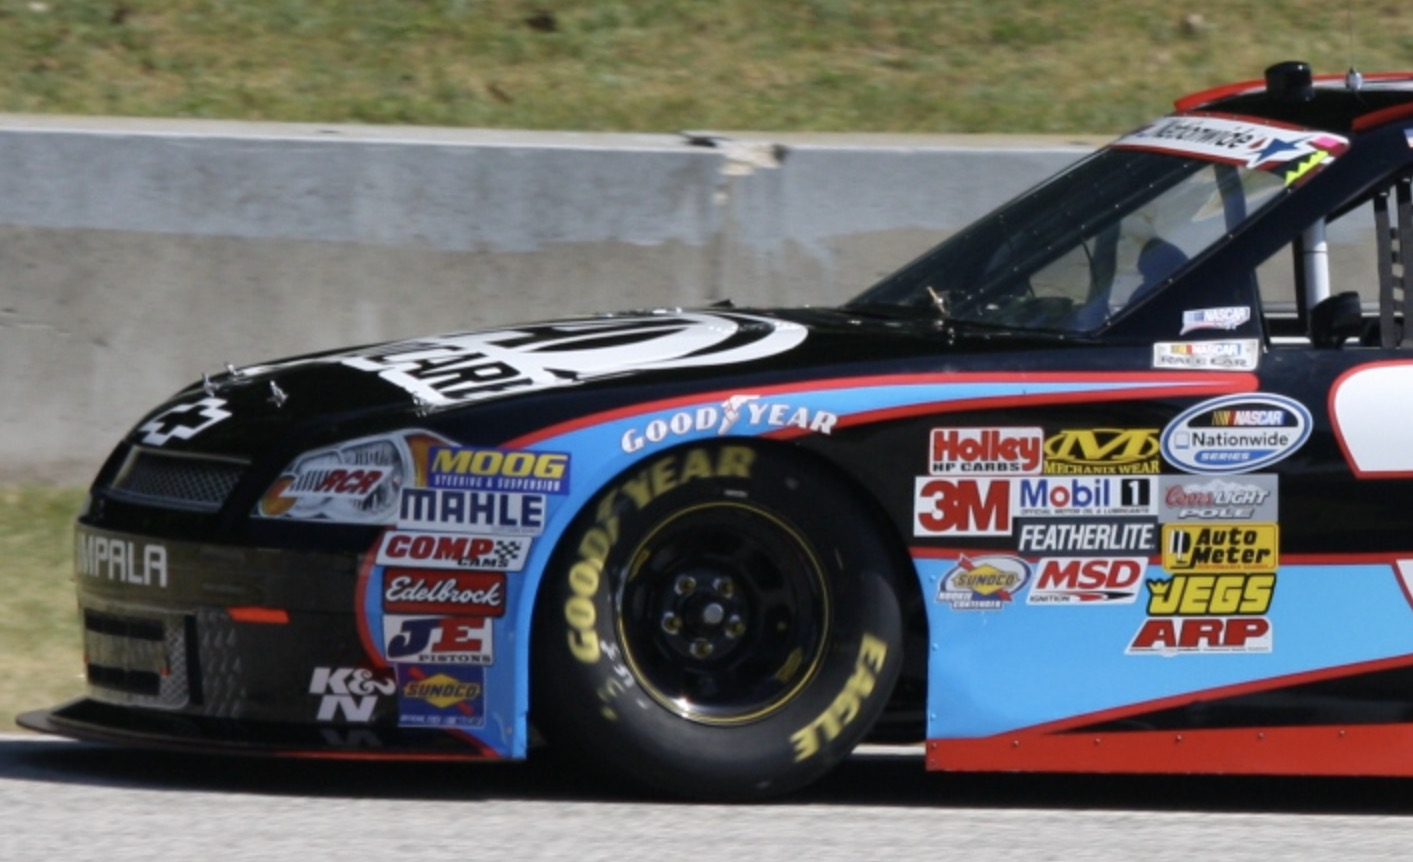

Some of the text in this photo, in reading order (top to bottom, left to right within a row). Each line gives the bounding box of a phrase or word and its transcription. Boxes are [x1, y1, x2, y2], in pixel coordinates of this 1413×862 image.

[1233, 410, 1284, 426] NASCAR
[1191, 431, 1289, 447] Nationwide
[933, 430, 1041, 471] Holley
[1200, 452, 1251, 462] SERIES
[431, 449, 568, 479] MOOG
[933, 462, 1021, 472] HP CARBS
[1043, 459, 1161, 474] MECHANIX WEAR
[435, 475, 482, 487] STEERING
[497, 477, 560, 492] SUSPENSION
[1020, 479, 1110, 508] Mobil
[401, 488, 543, 527] MAHLE
[917, 480, 1010, 533] 3M
[1215, 490, 1270, 506] LIGHT
[1178, 508, 1254, 519] POLE
[385, 535, 495, 560] COMP
[1019, 523, 1155, 551] FEATHERLITE
[1195, 528, 1258, 546] Auto
[456, 555, 510, 568] CAMS
[1190, 547, 1271, 569] Meter
[956, 573, 1017, 587] SUNOCO
[1036, 560, 1142, 590] MSD
[386, 576, 501, 606] Edelbrock
[1147, 573, 1277, 617] JEGS
[387, 617, 485, 658] JE
[1131, 618, 1270, 647] ARP
[418, 654, 491, 663] PISTONS
[405, 683, 480, 699] SUNOCO
[788, 632, 888, 763] EAGLE
